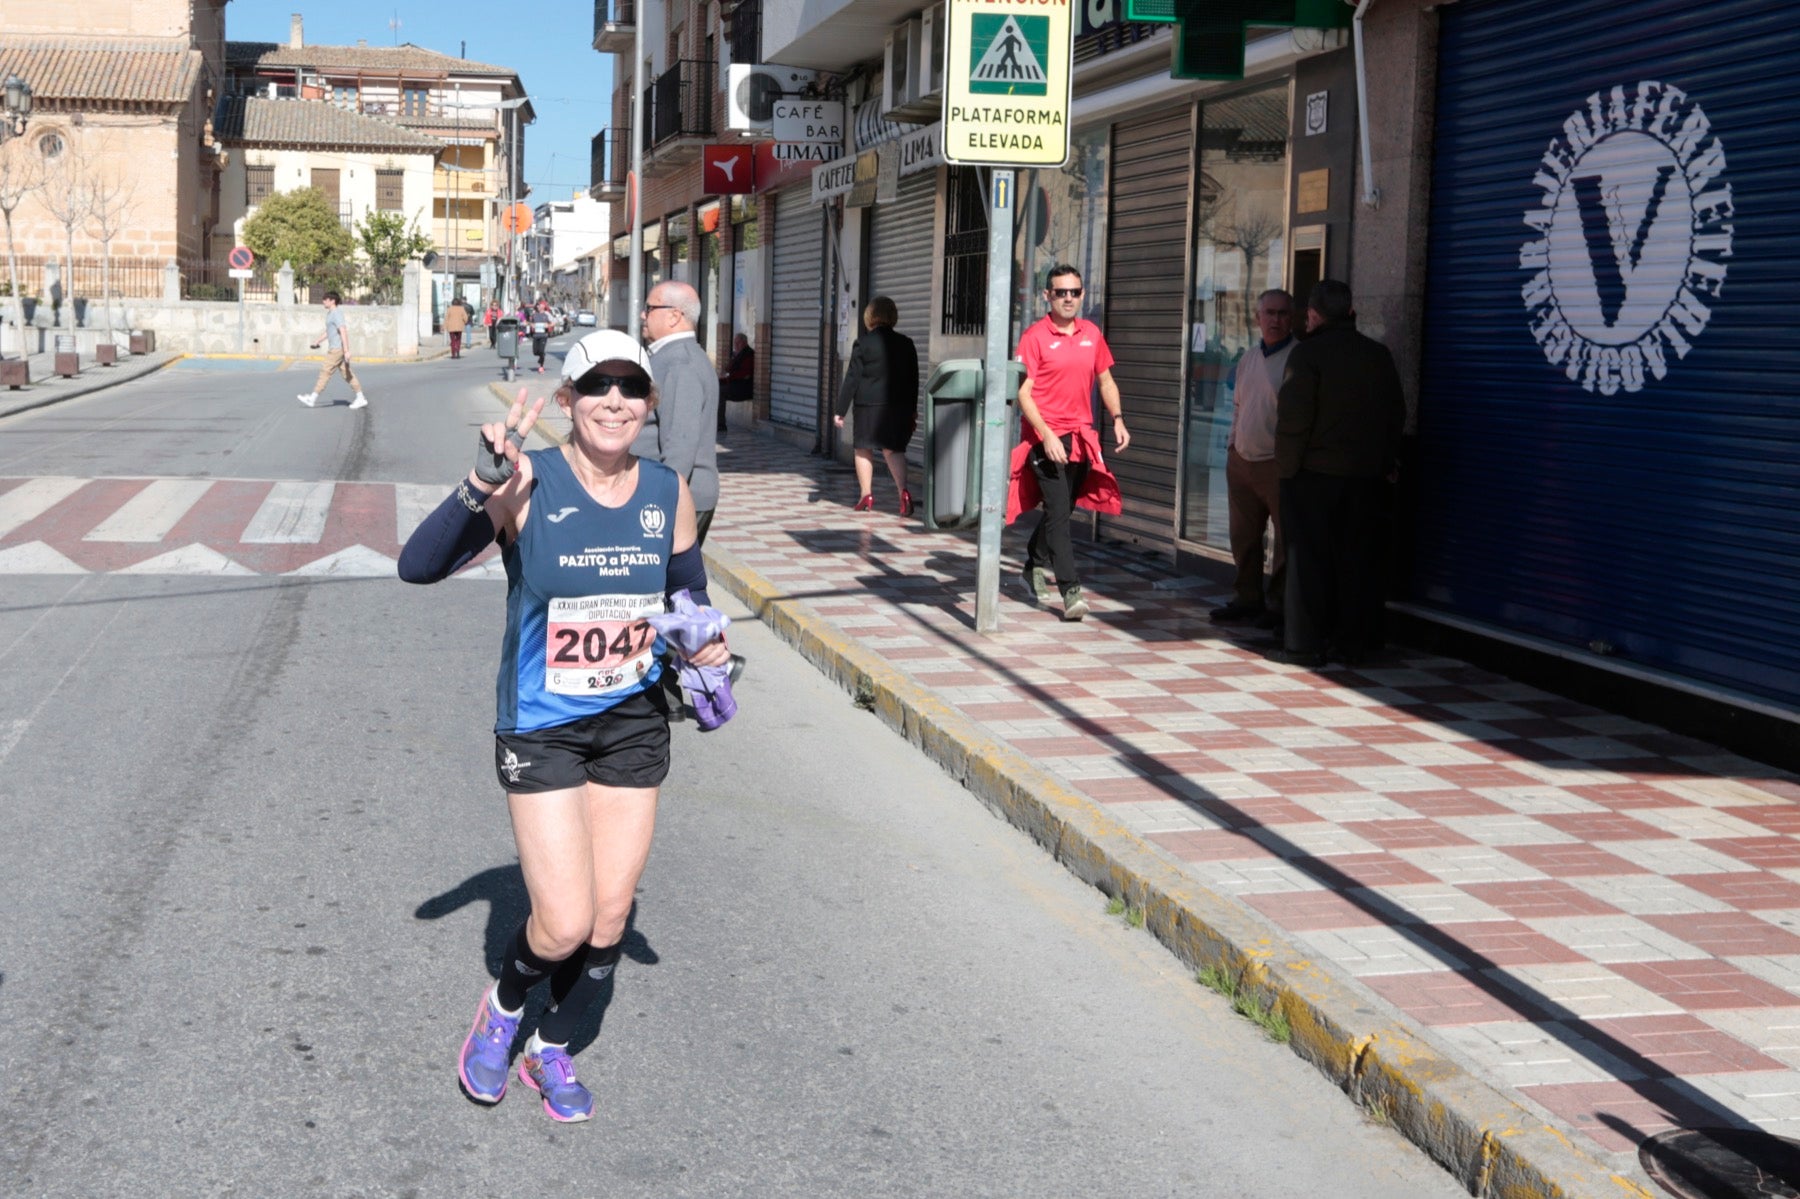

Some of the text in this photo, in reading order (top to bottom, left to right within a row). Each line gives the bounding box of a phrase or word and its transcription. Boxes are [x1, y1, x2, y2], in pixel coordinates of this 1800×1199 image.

[776, 104, 823, 119] CAFÉ
[951, 106, 1062, 126] PLATAFORMA
[806, 125, 840, 138] BAR
[904, 133, 934, 167] LIMA
[968, 132, 1043, 150] ELEVADA
[1570, 164, 1676, 328] V
[644, 510, 660, 528] 30
[559, 553, 660, 567] PAZITO a PAZITO
[599, 567, 630, 576] Motril
[557, 601, 578, 610] XXXIII
[580, 600, 598, 610] GRAN
[600, 598, 627, 608] PREMIO
[628, 598, 637, 608] DE
[554, 621, 650, 663] 2047
